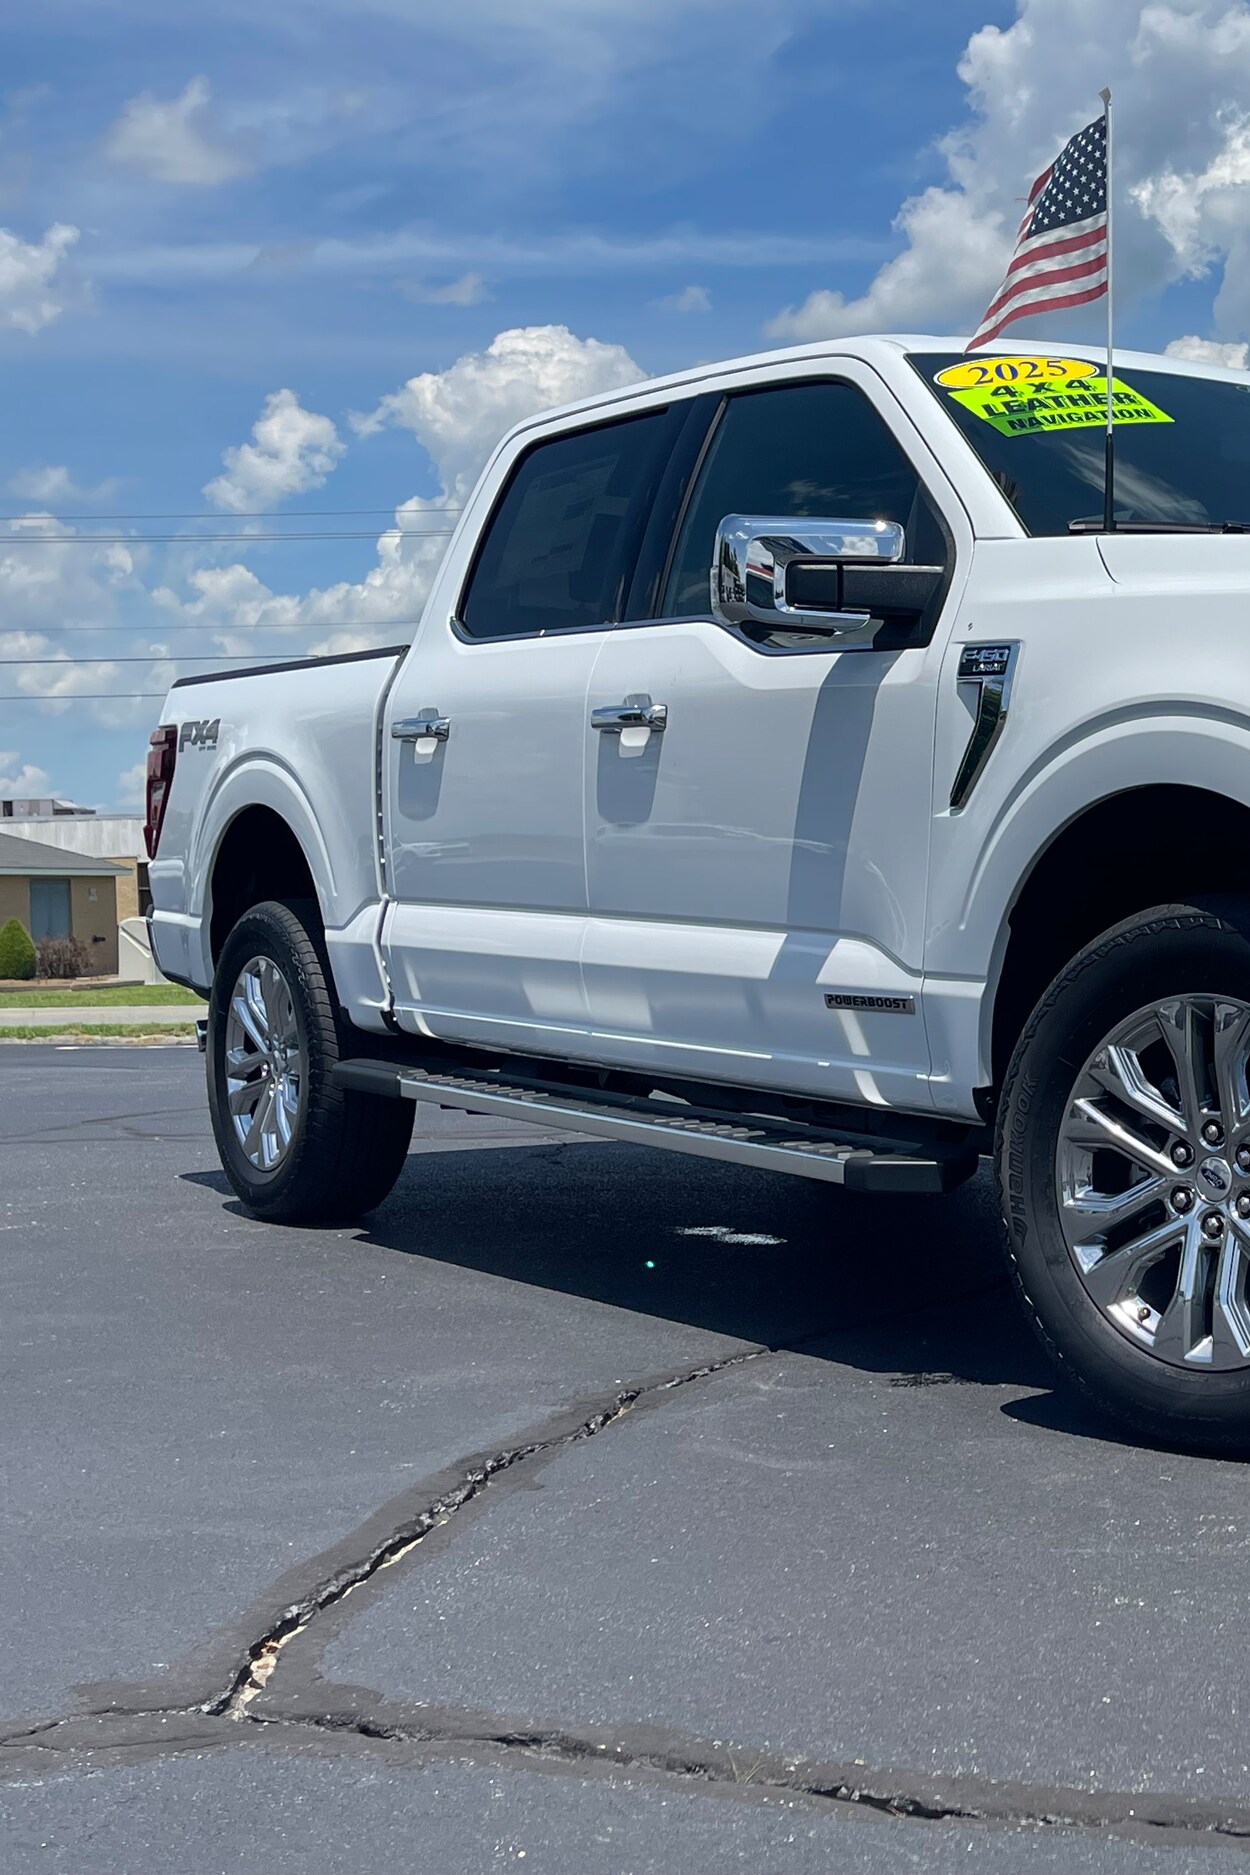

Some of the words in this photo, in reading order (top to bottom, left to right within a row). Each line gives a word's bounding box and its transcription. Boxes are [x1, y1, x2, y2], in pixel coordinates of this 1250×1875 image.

[968, 361, 1067, 385] 2025
[981, 392, 1142, 417] LEATHER
[1007, 408, 1155, 430] NAVIGATION
[962, 648, 1010, 663] F-150
[972, 661, 1005, 672] LARIAT
[178, 718, 221, 753] FX4
[827, 994, 908, 1010] POWERBOOST
